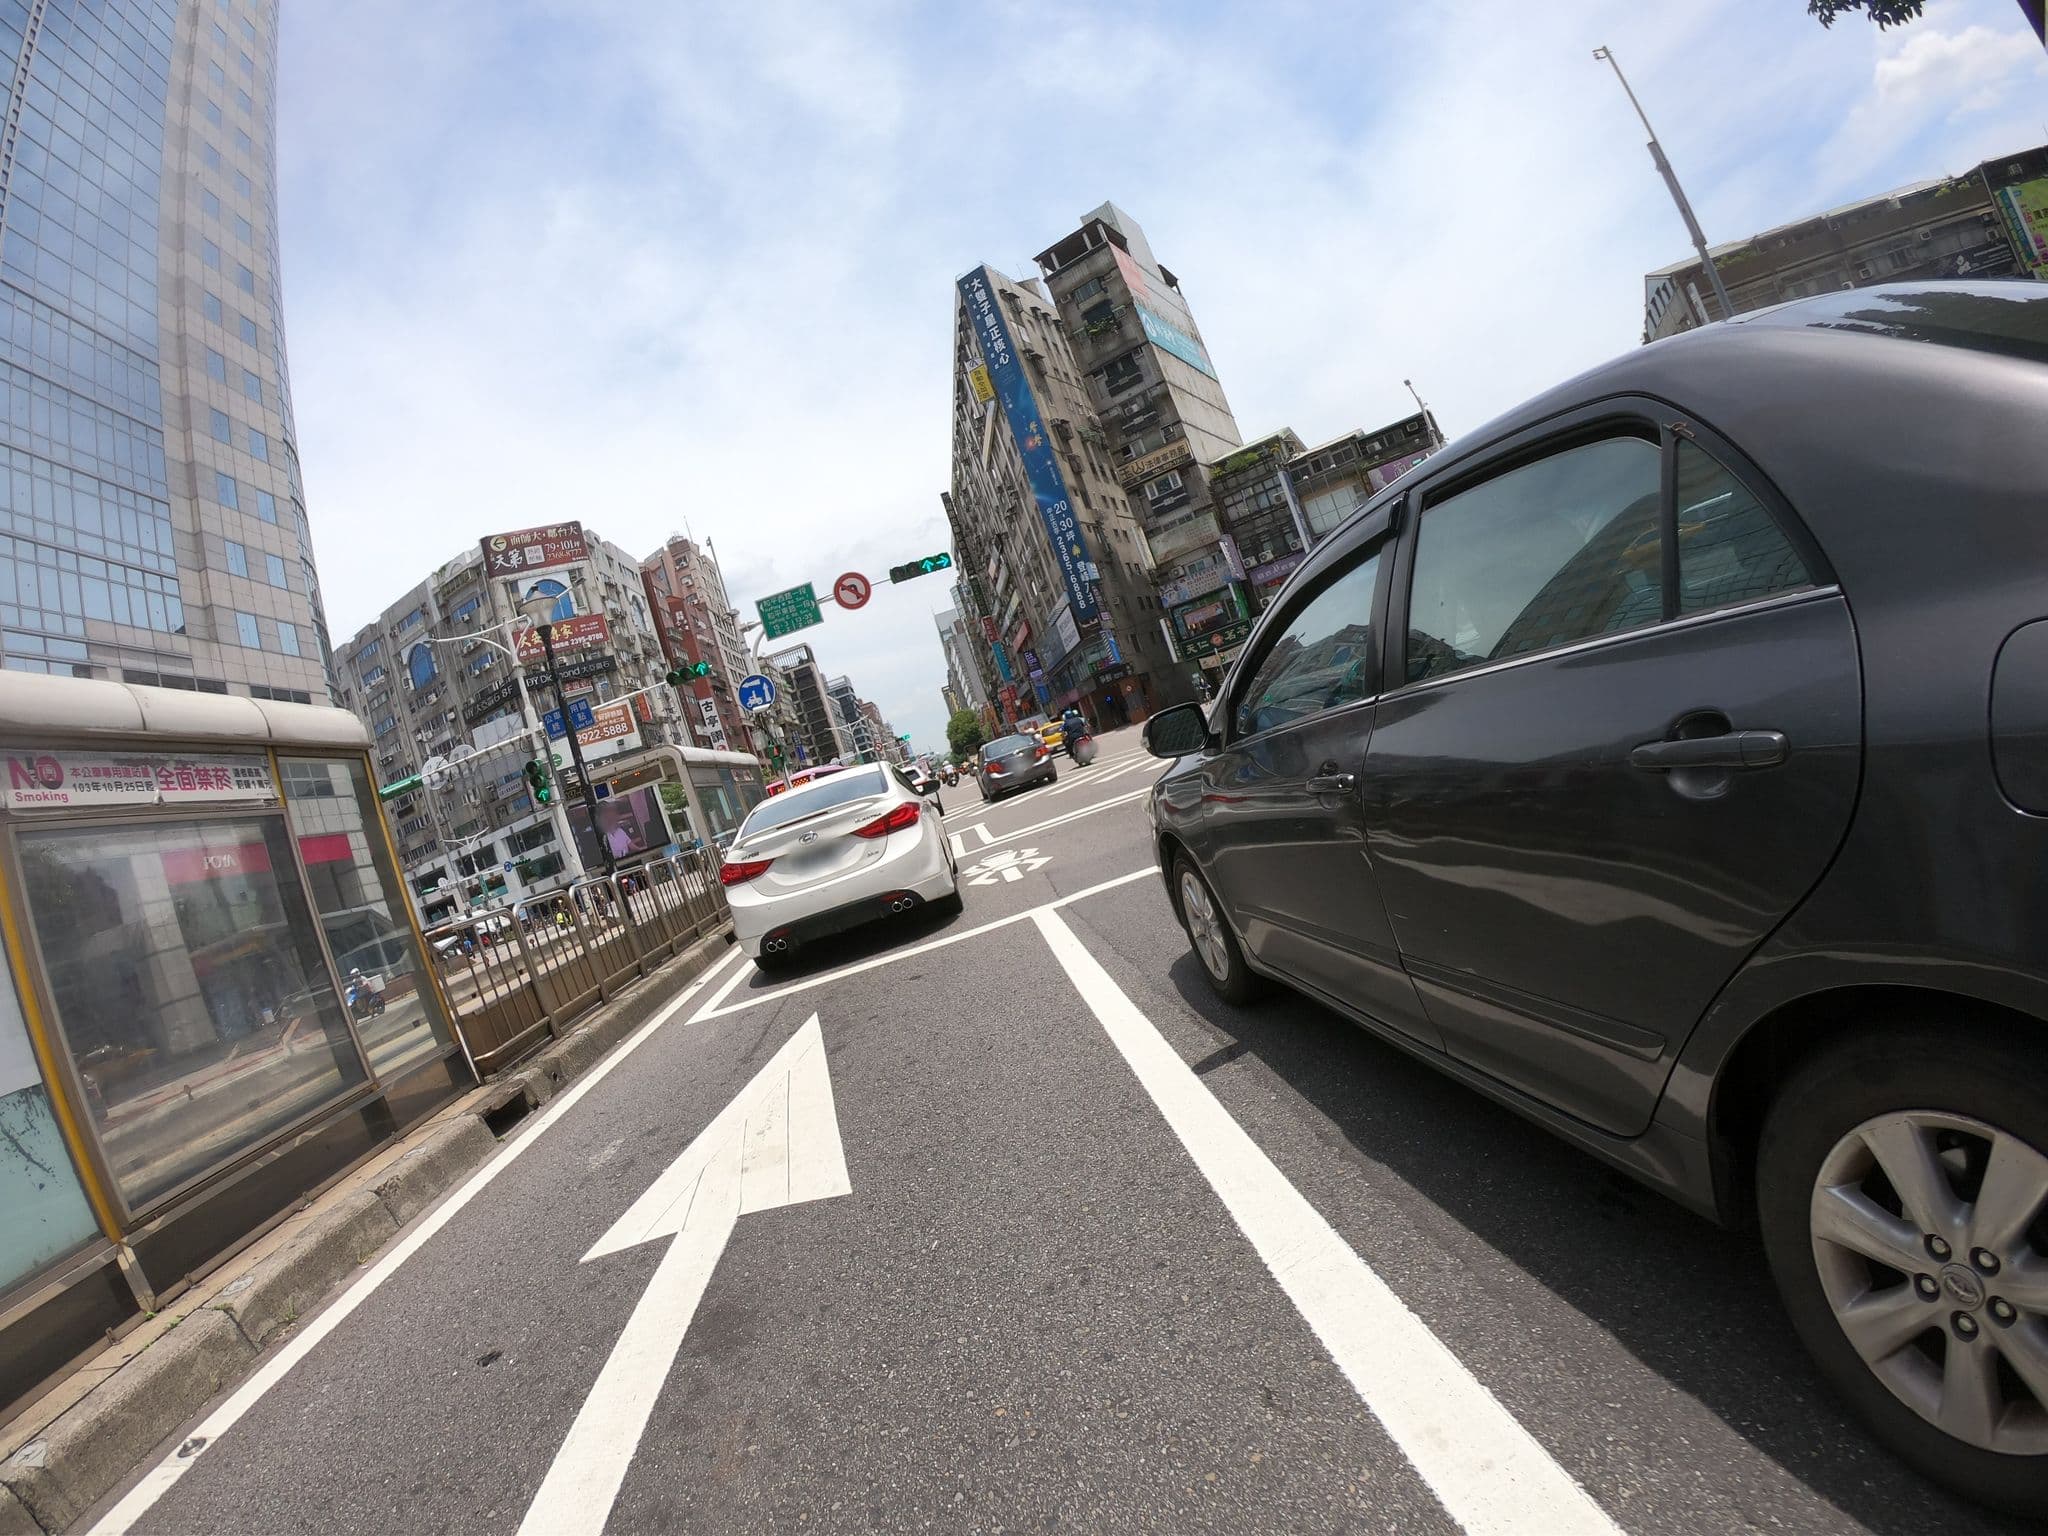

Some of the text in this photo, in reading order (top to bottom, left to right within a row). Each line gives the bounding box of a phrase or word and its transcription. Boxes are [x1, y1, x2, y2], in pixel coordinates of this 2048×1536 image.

[576, 723, 628, 744] 2922-5888
[157, 766, 233, 792] 全面禁菸
[15, 791, 69, 803] Smoking
